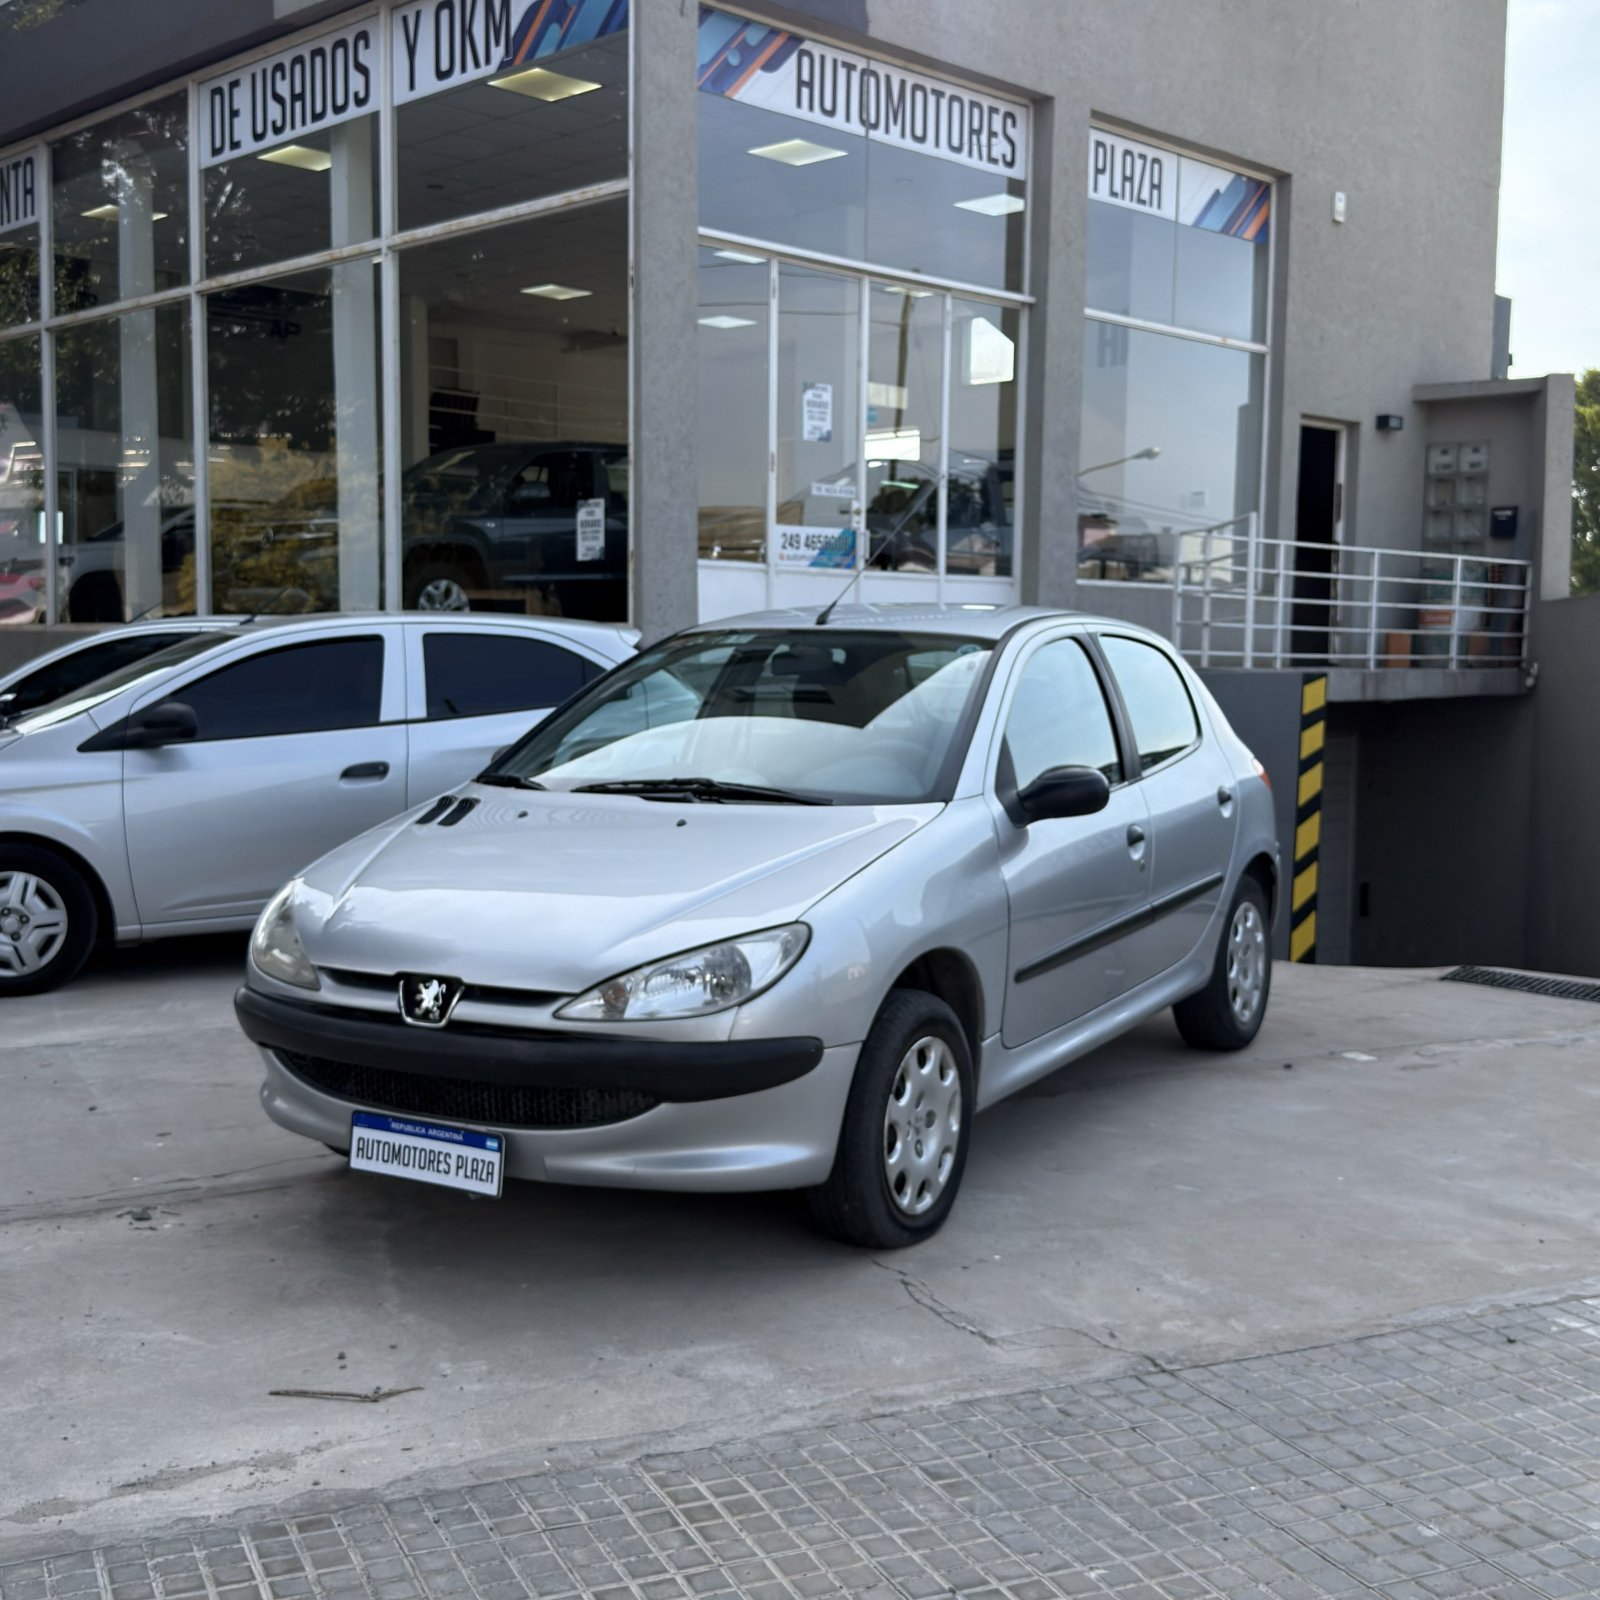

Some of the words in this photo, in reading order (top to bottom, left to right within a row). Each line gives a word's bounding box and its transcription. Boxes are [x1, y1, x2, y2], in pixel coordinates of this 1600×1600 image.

[210, 78, 242, 159] DE
[251, 29, 371, 143] USADOS
[402, 9, 421, 92] Y
[795, 47, 1017, 170] AUTOMOTORES
[1093, 139, 1162, 211] PLAZA
[780, 532, 802, 551] 249
[355, 1136, 452, 1176] AUTOMOTORES
[455, 1154, 496, 1185] PLAZA
[427, 1127, 464, 1141] ARGENTINA
